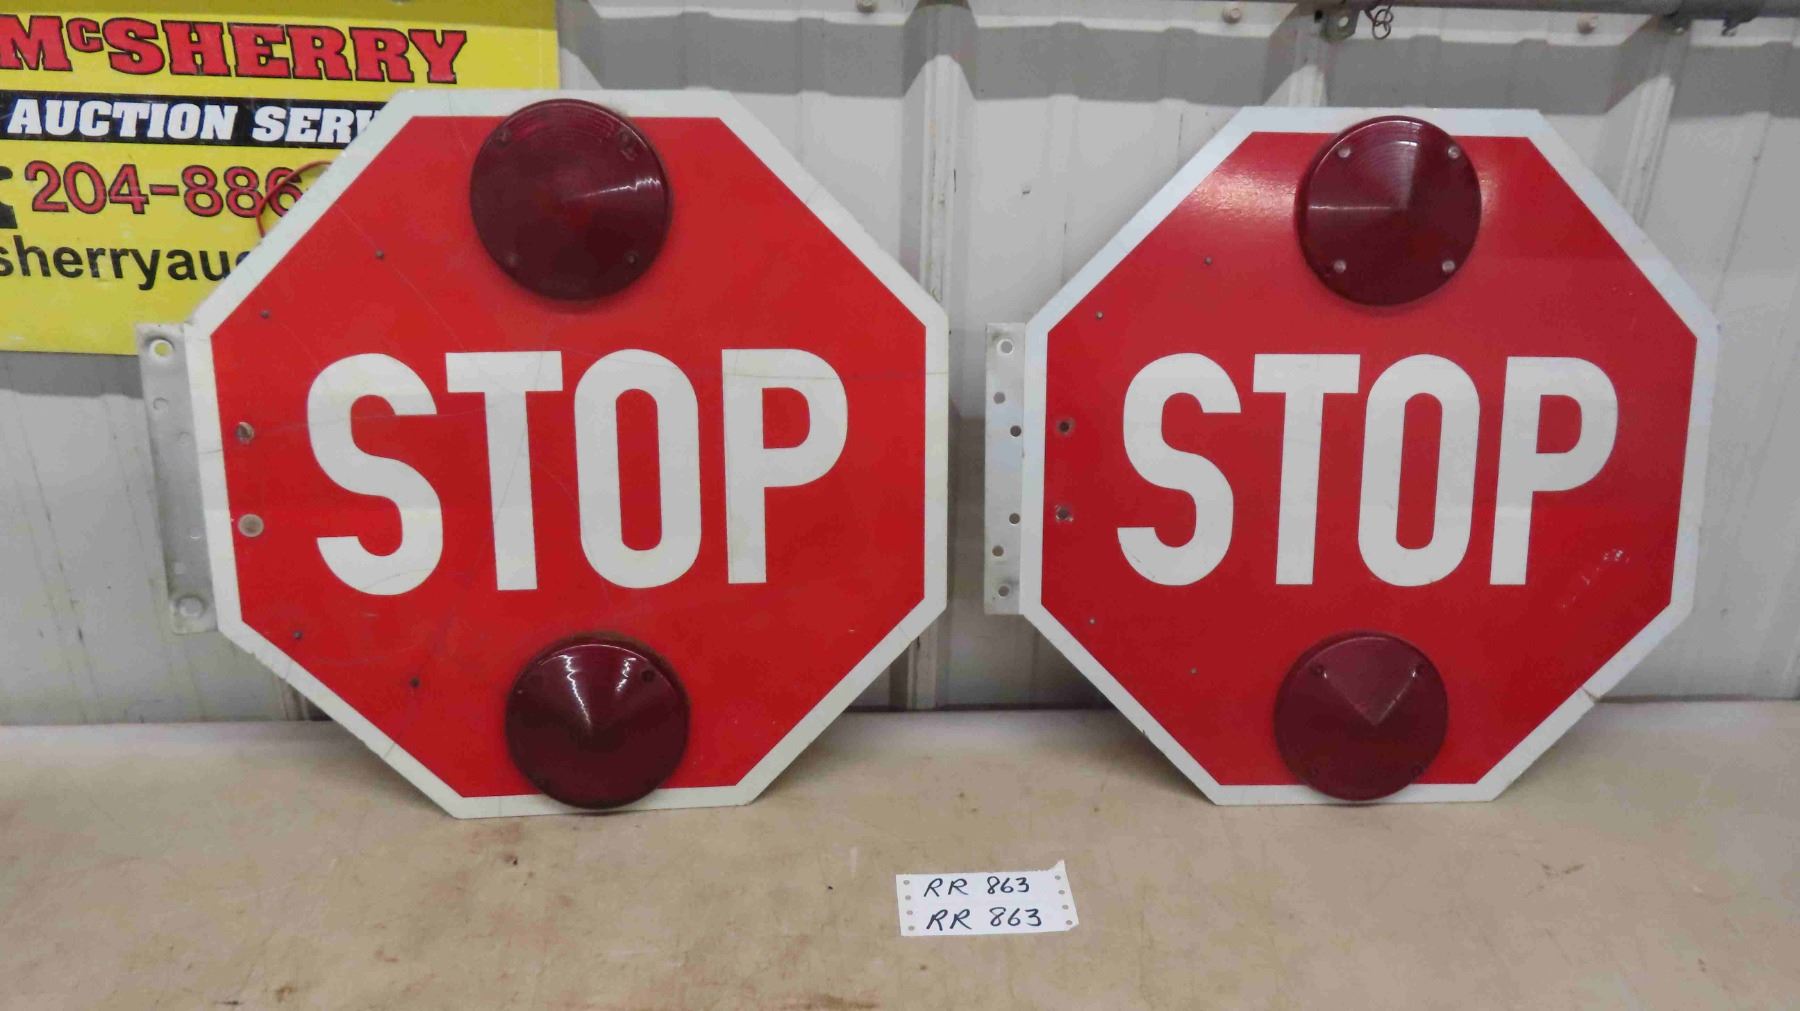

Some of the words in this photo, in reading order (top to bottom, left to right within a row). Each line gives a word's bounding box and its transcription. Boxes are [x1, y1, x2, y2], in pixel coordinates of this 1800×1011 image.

[7, 98, 238, 141] AUCTION
[307, 348, 848, 596] STOP
[1117, 352, 1618, 587] STOP
[986, 875, 1030, 895] 863
[989, 906, 1042, 927] 863
